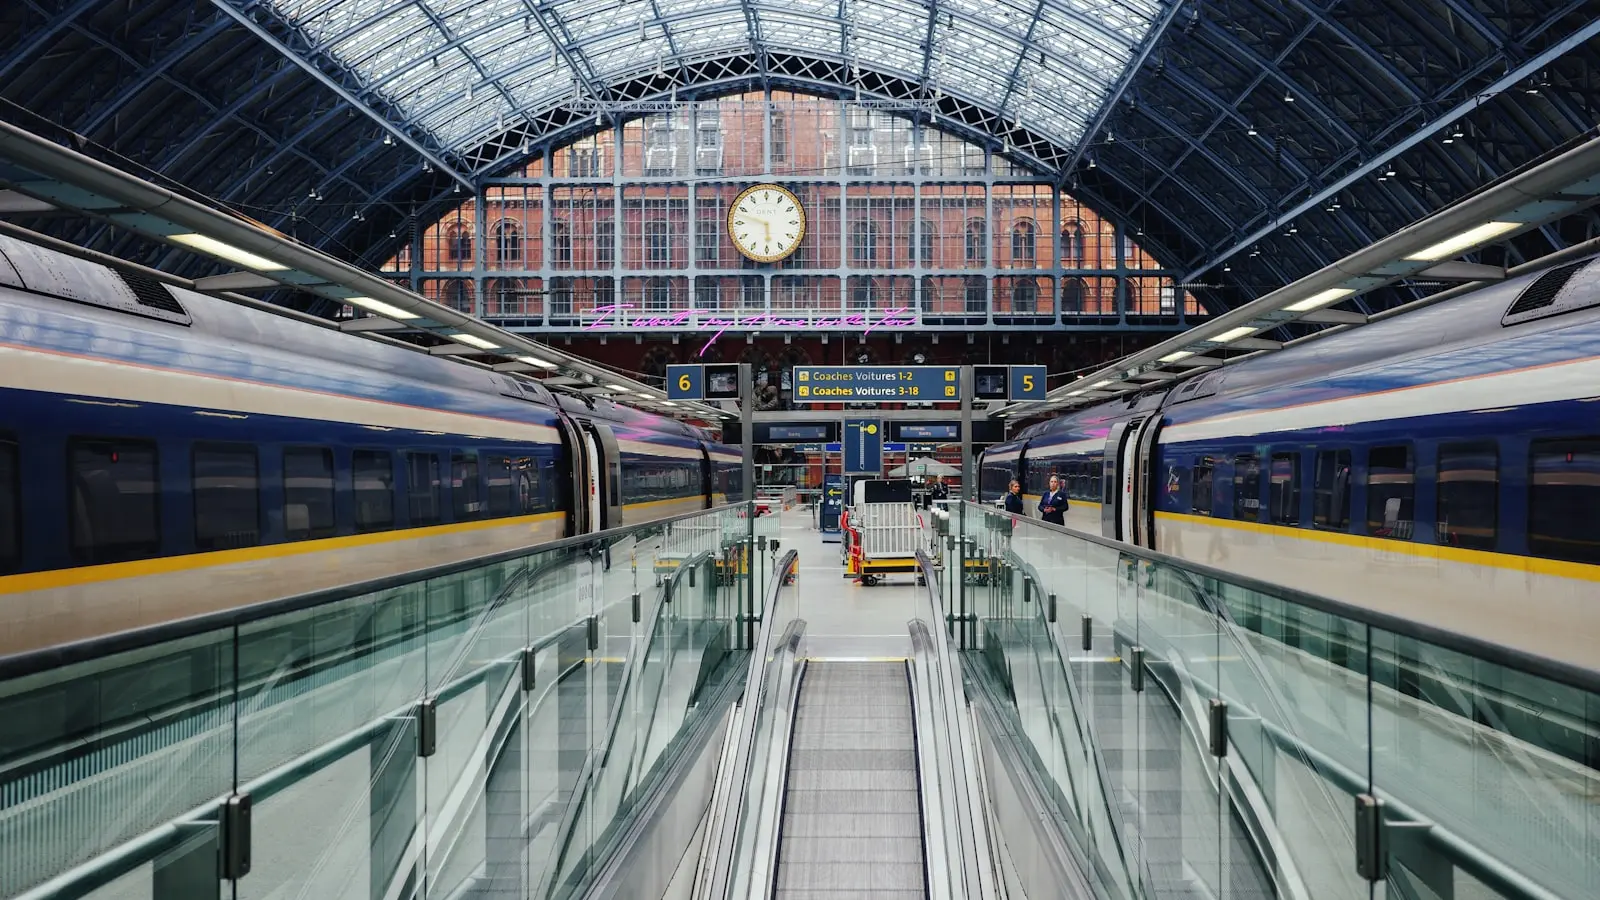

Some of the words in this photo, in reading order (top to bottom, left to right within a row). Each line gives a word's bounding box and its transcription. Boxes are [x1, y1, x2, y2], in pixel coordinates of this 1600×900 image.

[583, 303, 634, 331] I
[632, 309, 708, 327] want
[700, 317, 735, 357] my
[678, 374, 691, 391] 6
[813, 371, 853, 381] Coaches
[856, 371, 896, 381] Voitures
[899, 371, 913, 380] 1-2
[1023, 375, 1034, 391] 5
[813, 386, 853, 396] Coaches
[856, 386, 896, 396] Voitures
[899, 386, 919, 396] 3-18
